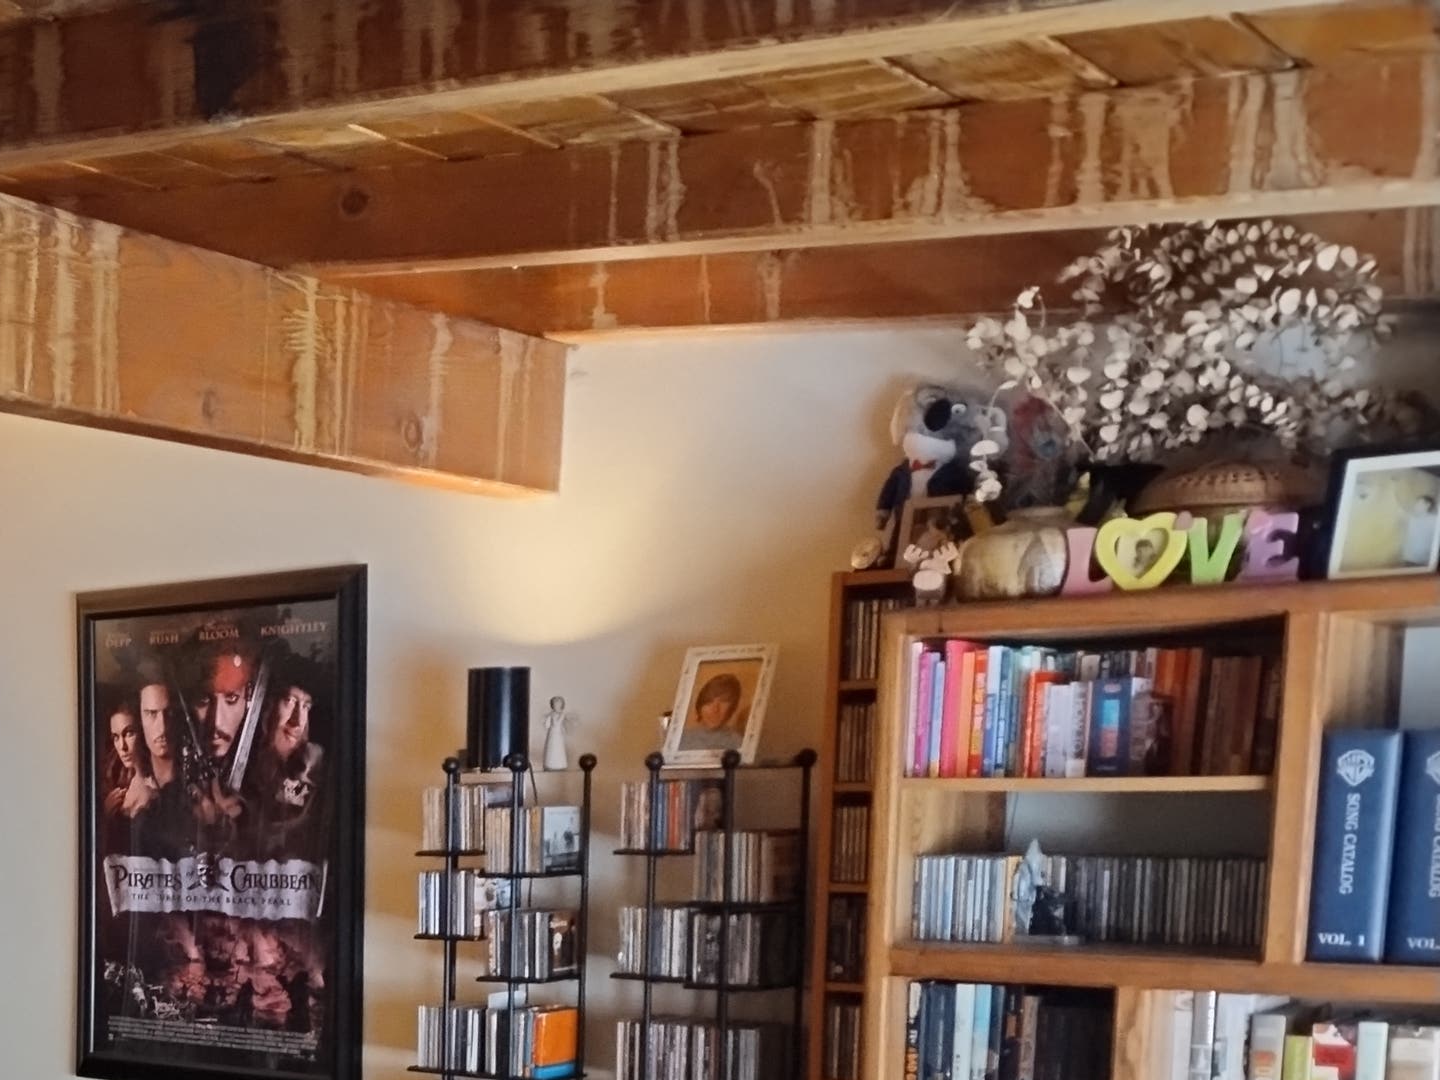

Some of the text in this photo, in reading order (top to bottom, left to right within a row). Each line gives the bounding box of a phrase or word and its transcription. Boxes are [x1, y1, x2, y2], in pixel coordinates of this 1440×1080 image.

[149, 633, 178, 645] RUSH
[199, 629, 240, 641] BLOOM
[261, 622, 328, 637] KNIGHTLEY
[1339, 793, 1361, 894] SONG CATALOG
[1318, 932, 1352, 946] VOL.
